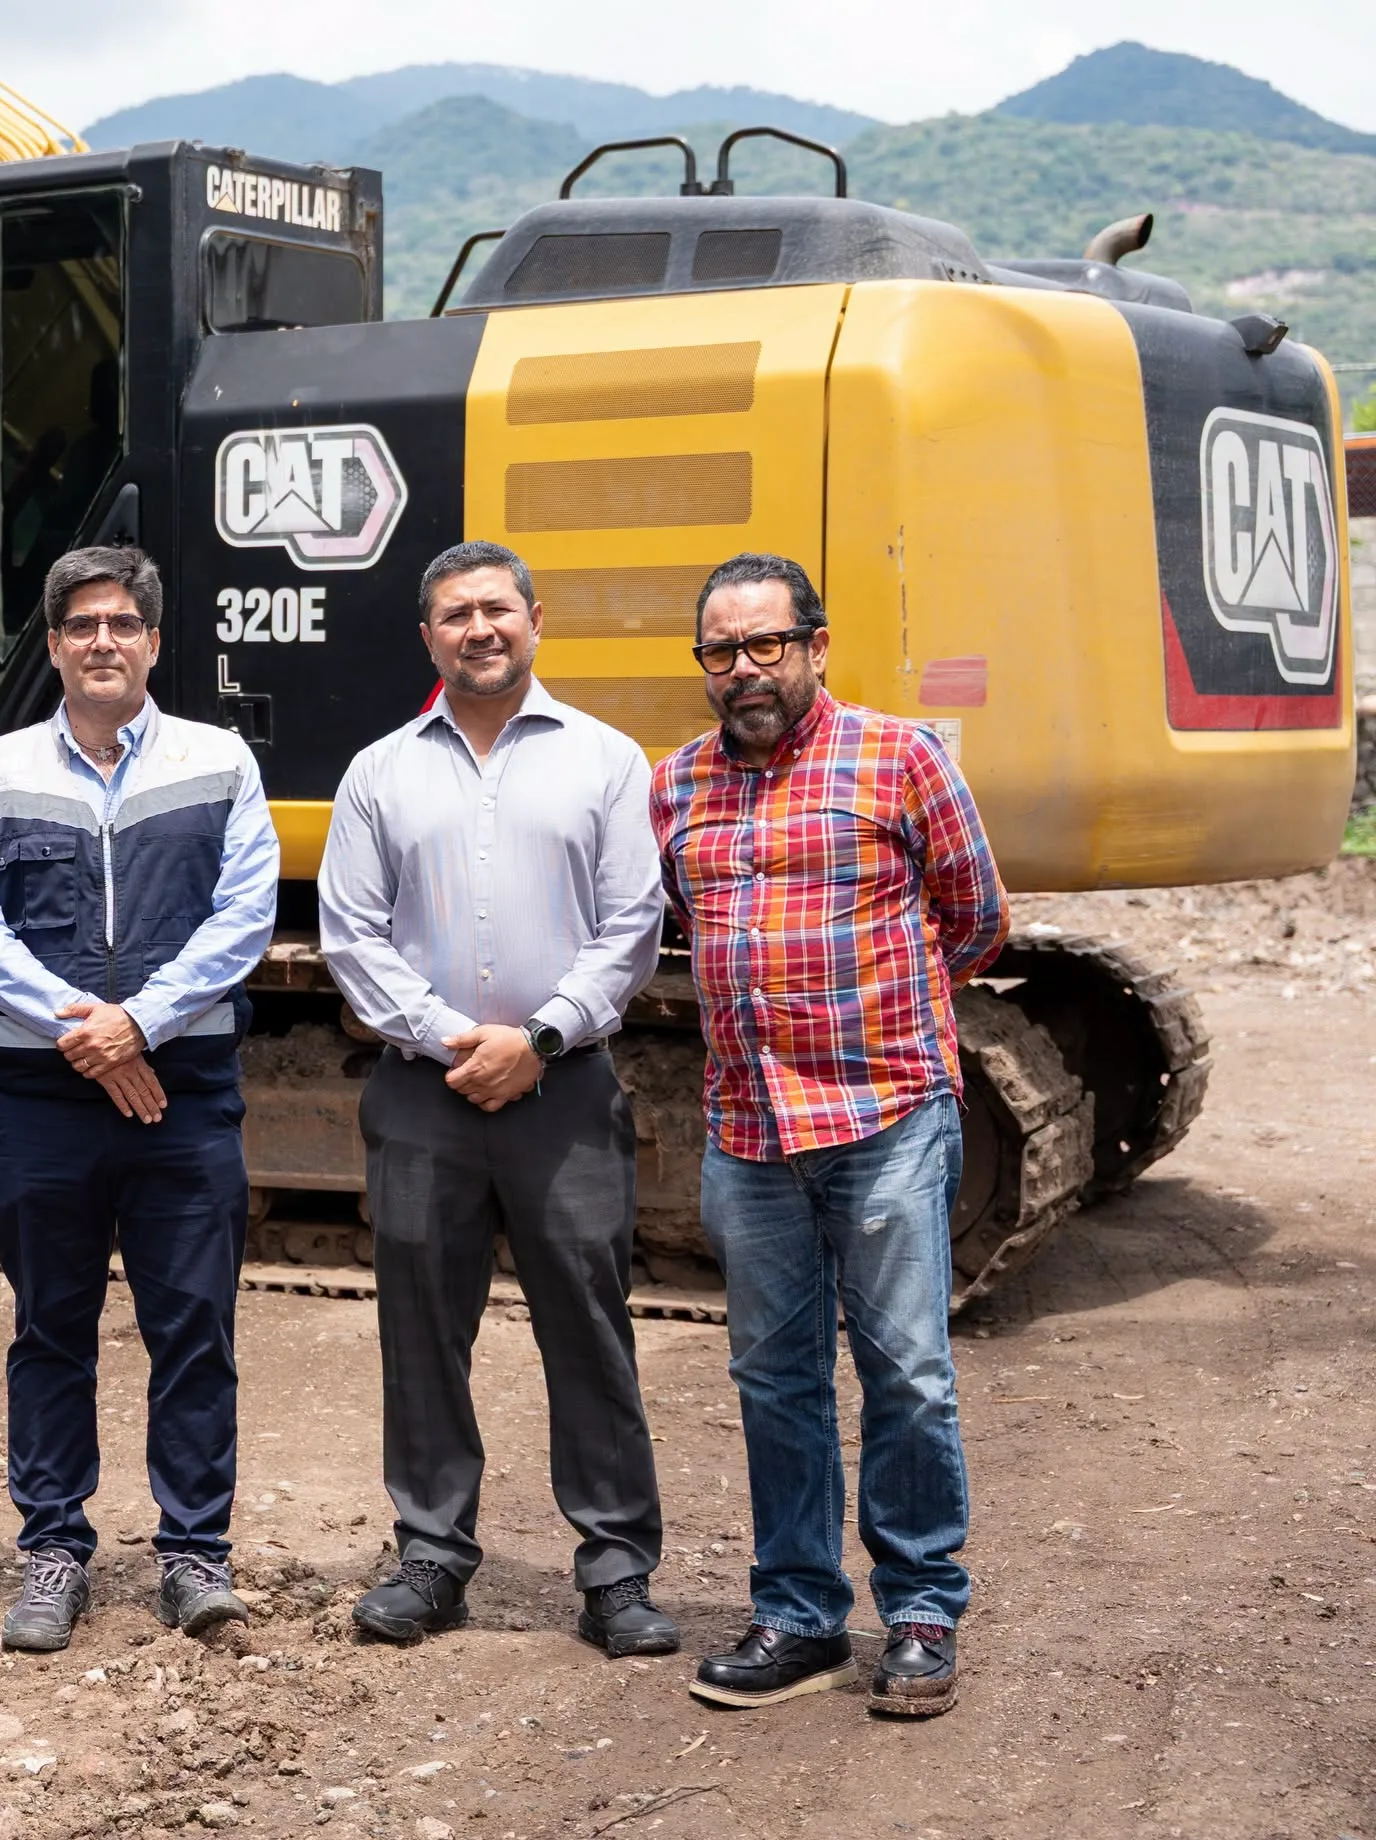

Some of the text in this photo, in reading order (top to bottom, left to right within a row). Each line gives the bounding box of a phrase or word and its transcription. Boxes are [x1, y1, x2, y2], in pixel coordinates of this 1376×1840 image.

[206, 165, 341, 233] CATERPILLAR
[225, 438, 354, 535] CAT
[1211, 430, 1311, 613] CAT
[216, 587, 327, 643] 320E
[217, 654, 241, 693] L
